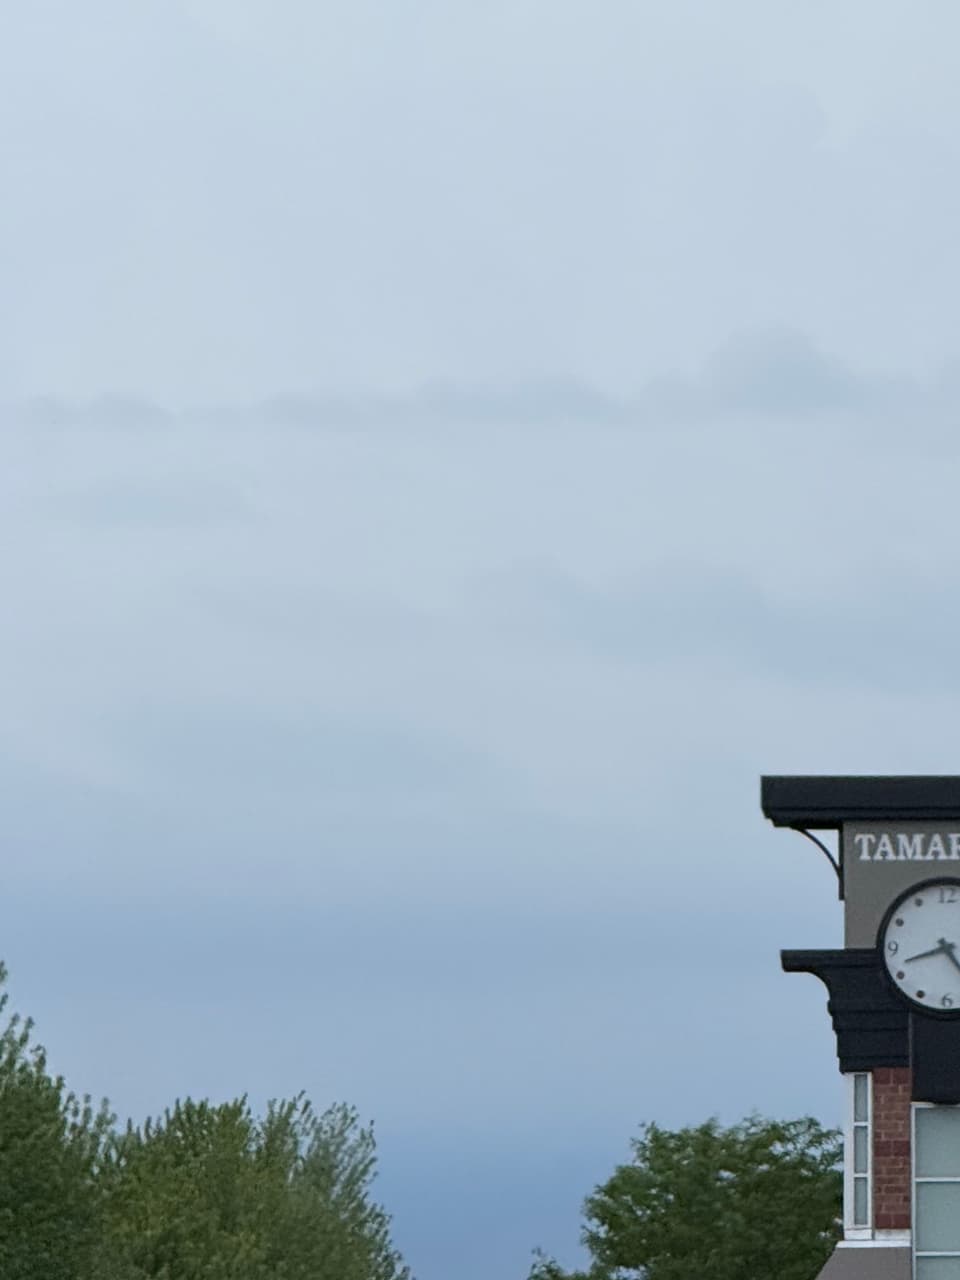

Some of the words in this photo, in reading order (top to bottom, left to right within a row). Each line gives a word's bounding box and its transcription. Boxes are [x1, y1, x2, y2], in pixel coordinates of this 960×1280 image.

[937, 887, 958, 904] 12
[888, 940, 899, 957] 9
[942, 993, 953, 1008] 6
